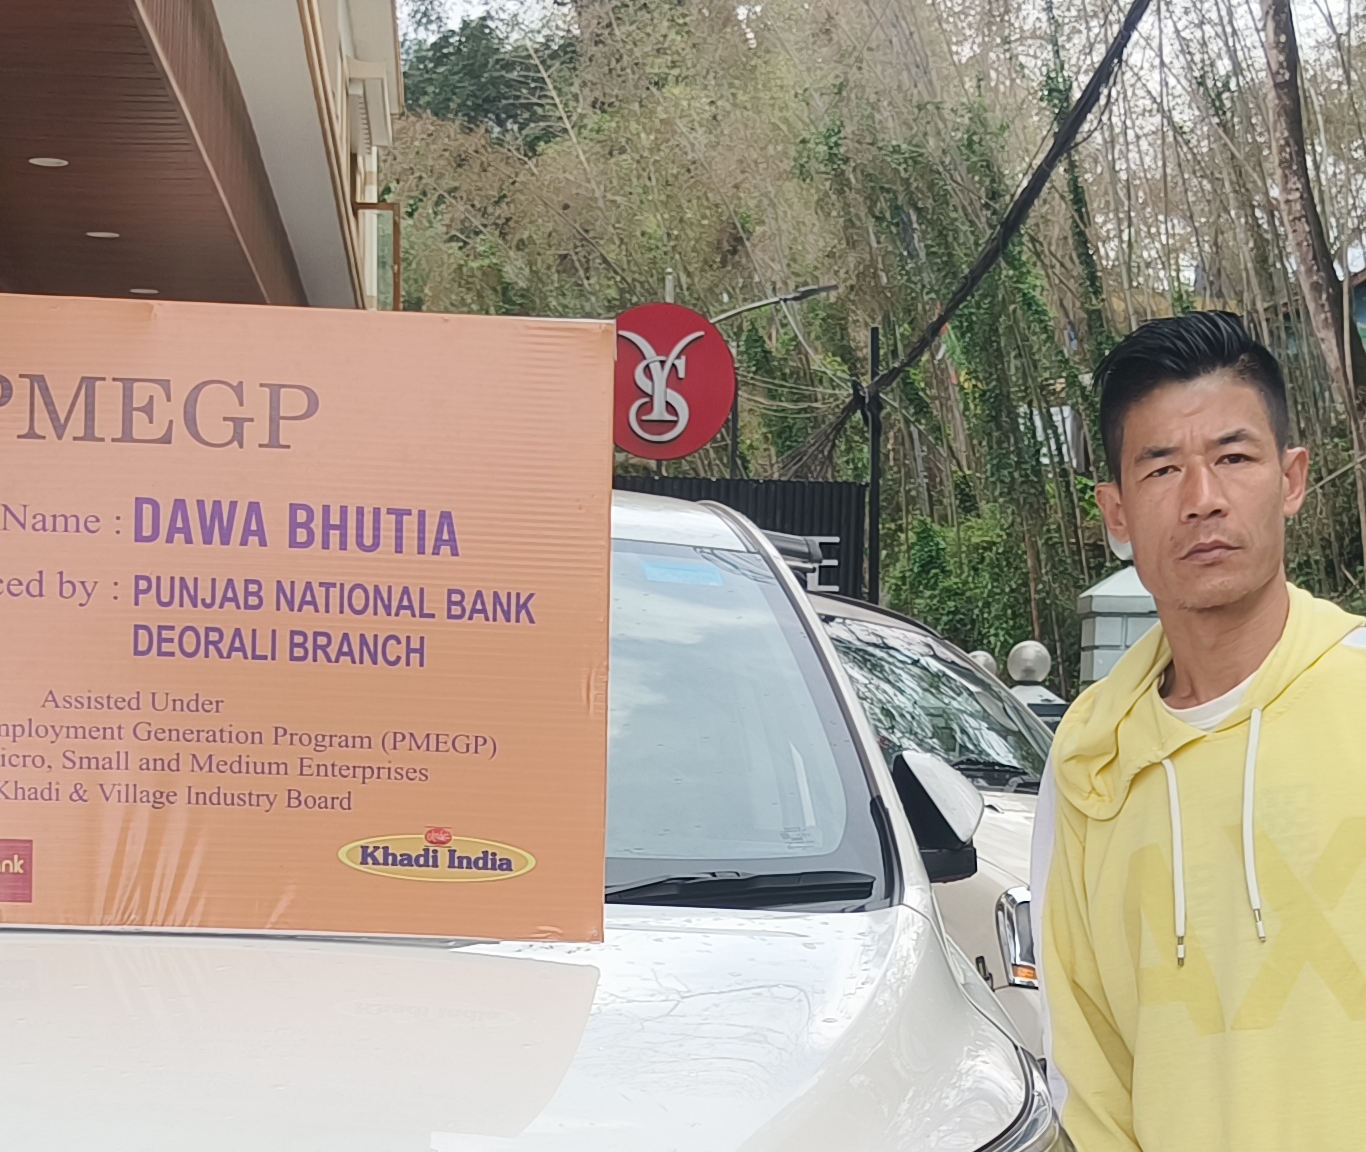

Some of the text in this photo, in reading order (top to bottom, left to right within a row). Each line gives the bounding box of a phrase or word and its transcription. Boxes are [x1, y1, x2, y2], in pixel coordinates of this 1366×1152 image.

[0, 503, 101, 535] Name
[133, 496, 268, 548] DAWA
[288, 502, 460, 558] BHUTIA
[56, 570, 99, 608] by
[133, 574, 264, 612] PUNJAB
[275, 580, 436, 620] NATIONAL
[446, 588, 537, 625] BANK
[132, 623, 426, 668] DEORALI BRANCH
[39, 689, 225, 714] Assisted Under
[132, 721, 264, 747] Generation
[271, 726, 374, 754] Program
[381, 730, 497, 761] (PMEGP)
[61, 750, 130, 772] Small
[138, 752, 182, 773] and
[188, 753, 290, 776] Medium
[296, 756, 429, 785] Enterprises
[68, 782, 91, 803] &
[97, 783, 178, 810] Village
[186, 785, 279, 813] Industry
[285, 788, 353, 811] Board
[359, 845, 514, 872] Khadi India
